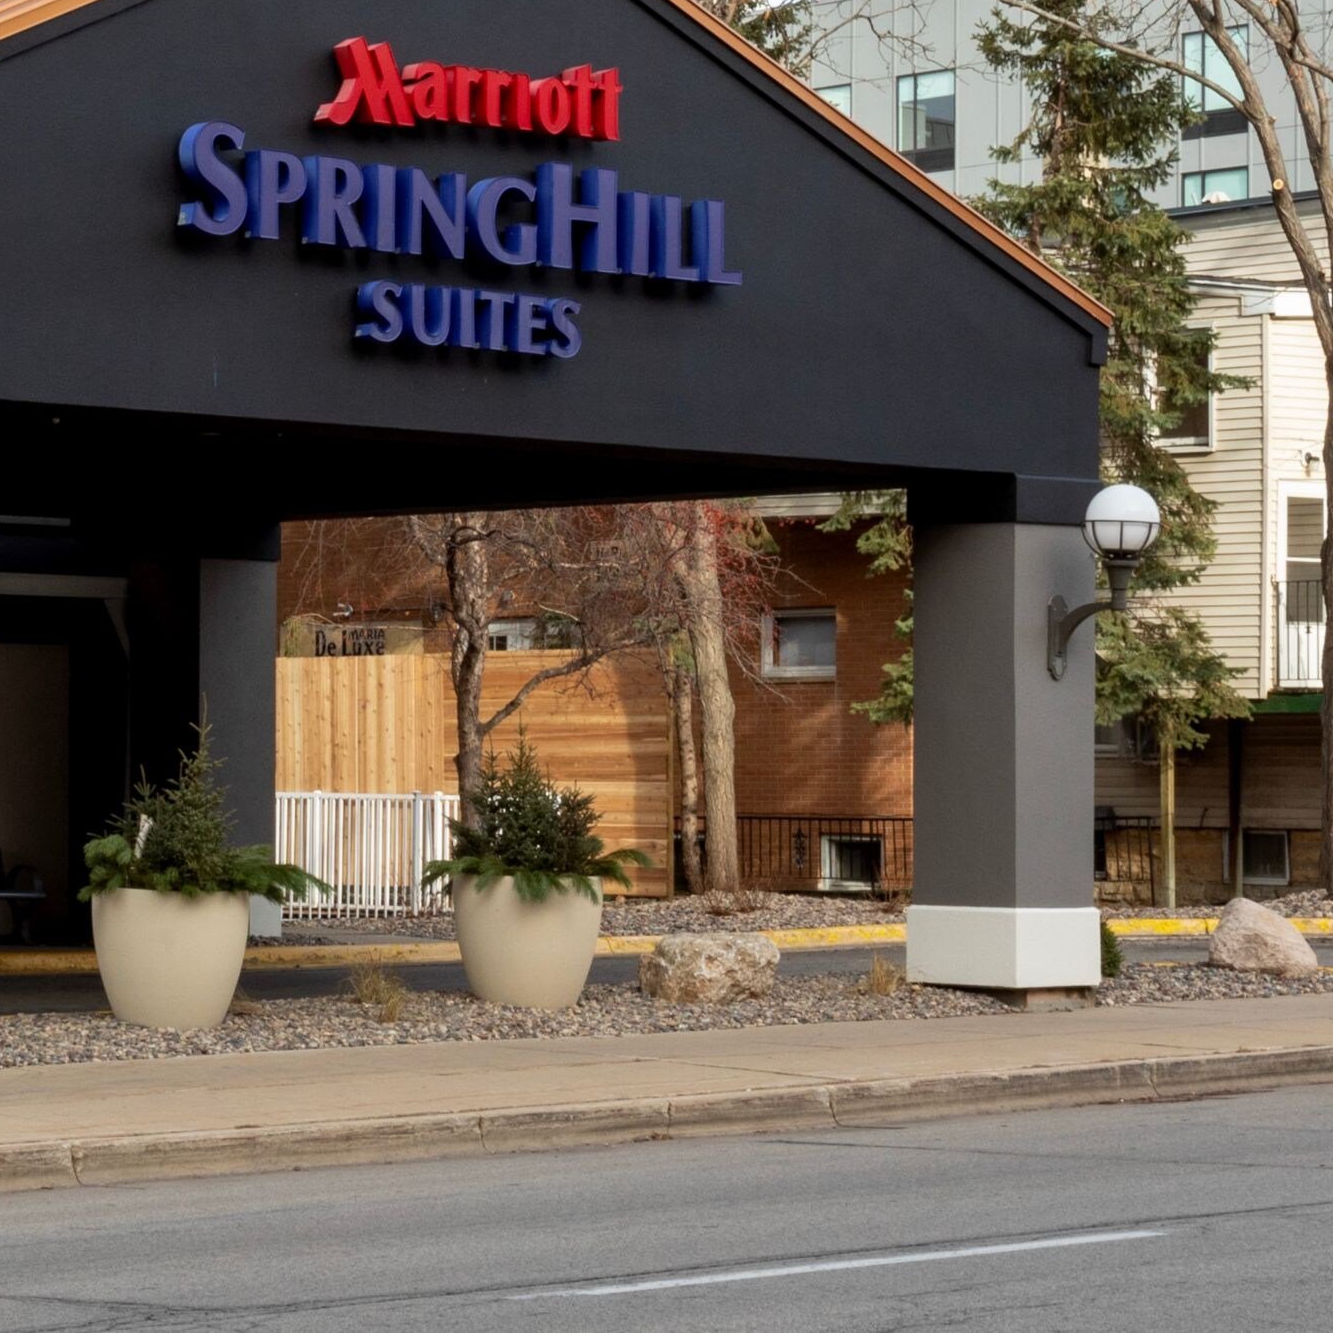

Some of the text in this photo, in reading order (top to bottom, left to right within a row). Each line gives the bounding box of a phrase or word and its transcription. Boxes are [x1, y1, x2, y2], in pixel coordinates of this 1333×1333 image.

[313, 36, 623, 141] Marriott
[178, 120, 743, 285] SPRINGHILL
[354, 279, 582, 358] SUITES
[315, 629, 337, 657] De
